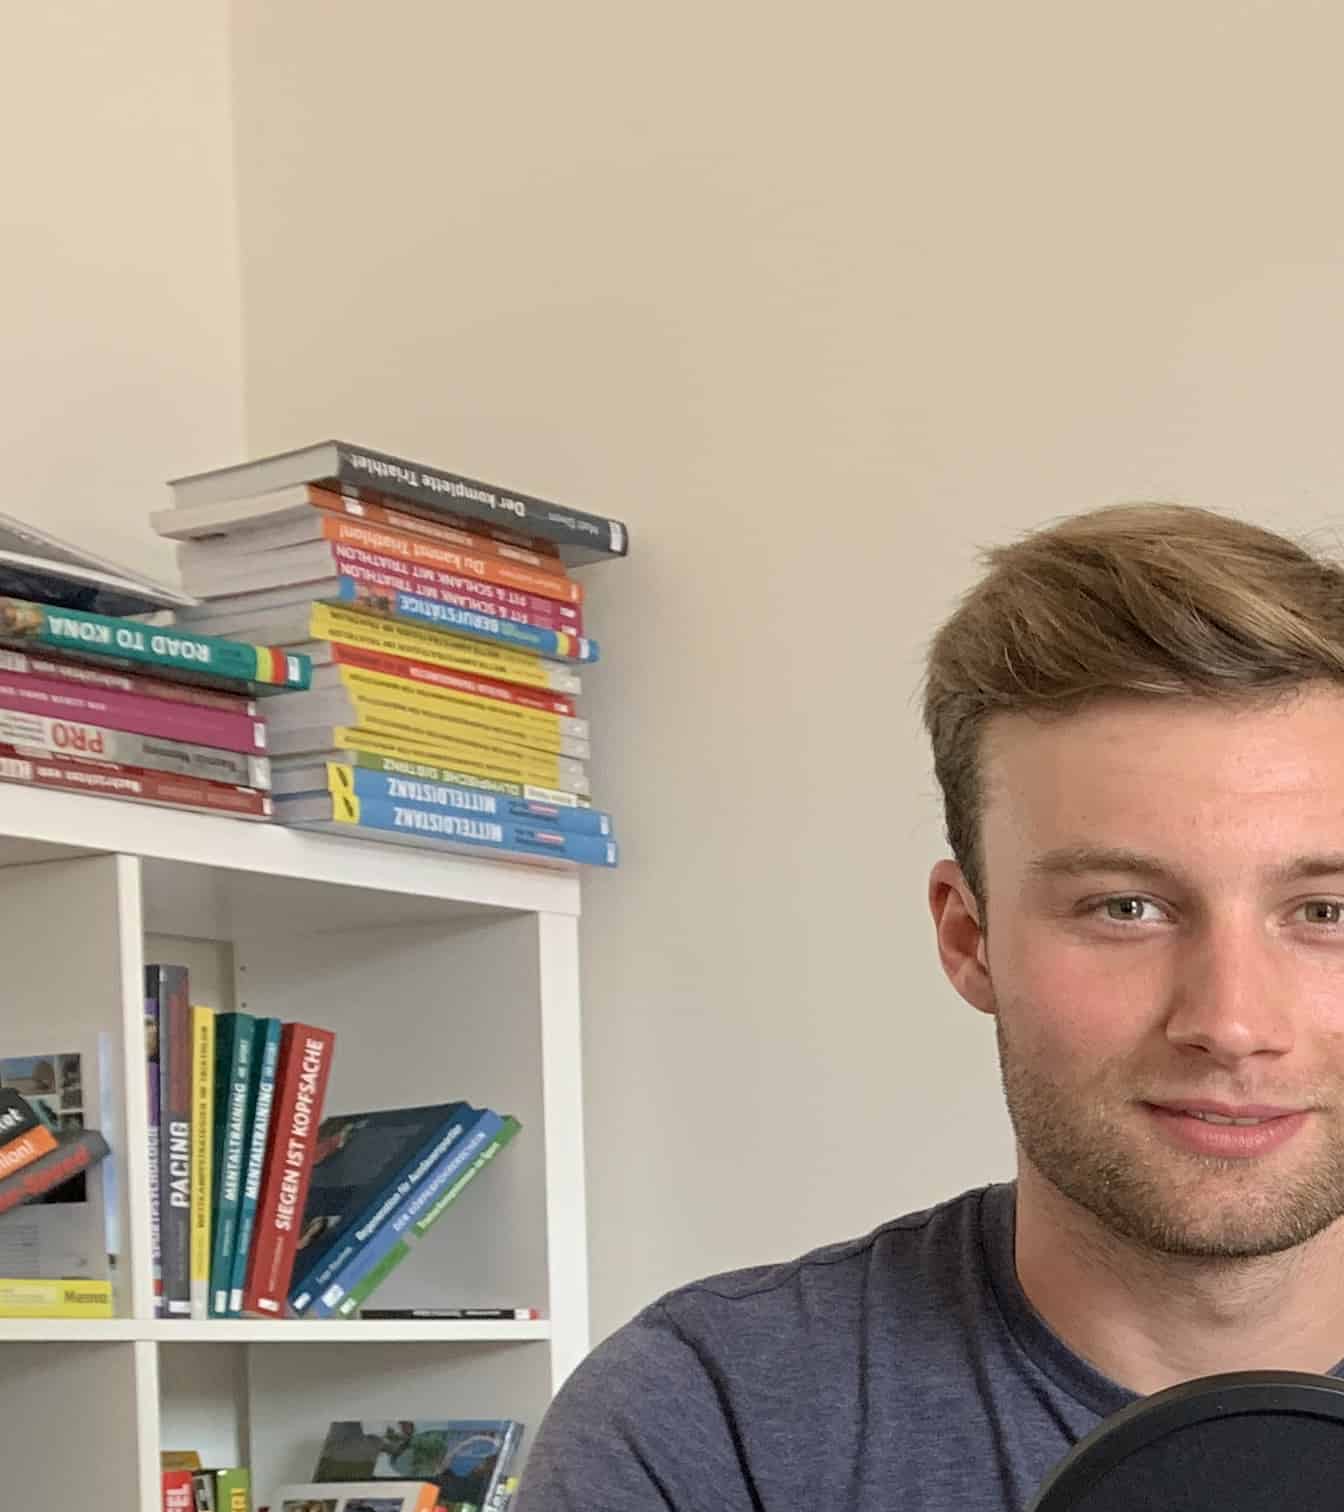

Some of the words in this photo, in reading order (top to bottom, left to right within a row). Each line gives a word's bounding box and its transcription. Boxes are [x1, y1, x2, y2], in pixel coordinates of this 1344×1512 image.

[350, 454, 420, 487] Triathlet
[421, 474, 497, 510] komplette
[498, 497, 526, 518] Der
[336, 543, 410, 576] TRIATHLON
[413, 543, 462, 570] kannst
[463, 557, 485, 576] Du
[413, 565, 436, 581] MIT
[438, 571, 495, 598] SCHLANK
[416, 583, 437, 599] MIT
[440, 589, 497, 616] SCHLANK
[496, 588, 506, 601] &
[509, 591, 528, 607] FIT
[48, 615, 112, 645] KONA
[511, 608, 528, 624] FIT
[115, 628, 144, 651] TO
[151, 635, 211, 663] ROAD
[51, 722, 105, 754] PRO
[386, 776, 497, 814] MITTELDISTANZ
[393, 805, 503, 842] MITTELDISTANZ
[288, 1039, 324, 1138] KOPFSACHE
[222, 1081, 249, 1201] MENTALTRAINING
[244, 1081, 273, 1199] MENTALTRAINING
[283, 1137, 307, 1168] IST
[169, 1120, 189, 1208] PACING
[272, 1169, 301, 1232] SIEGEN
